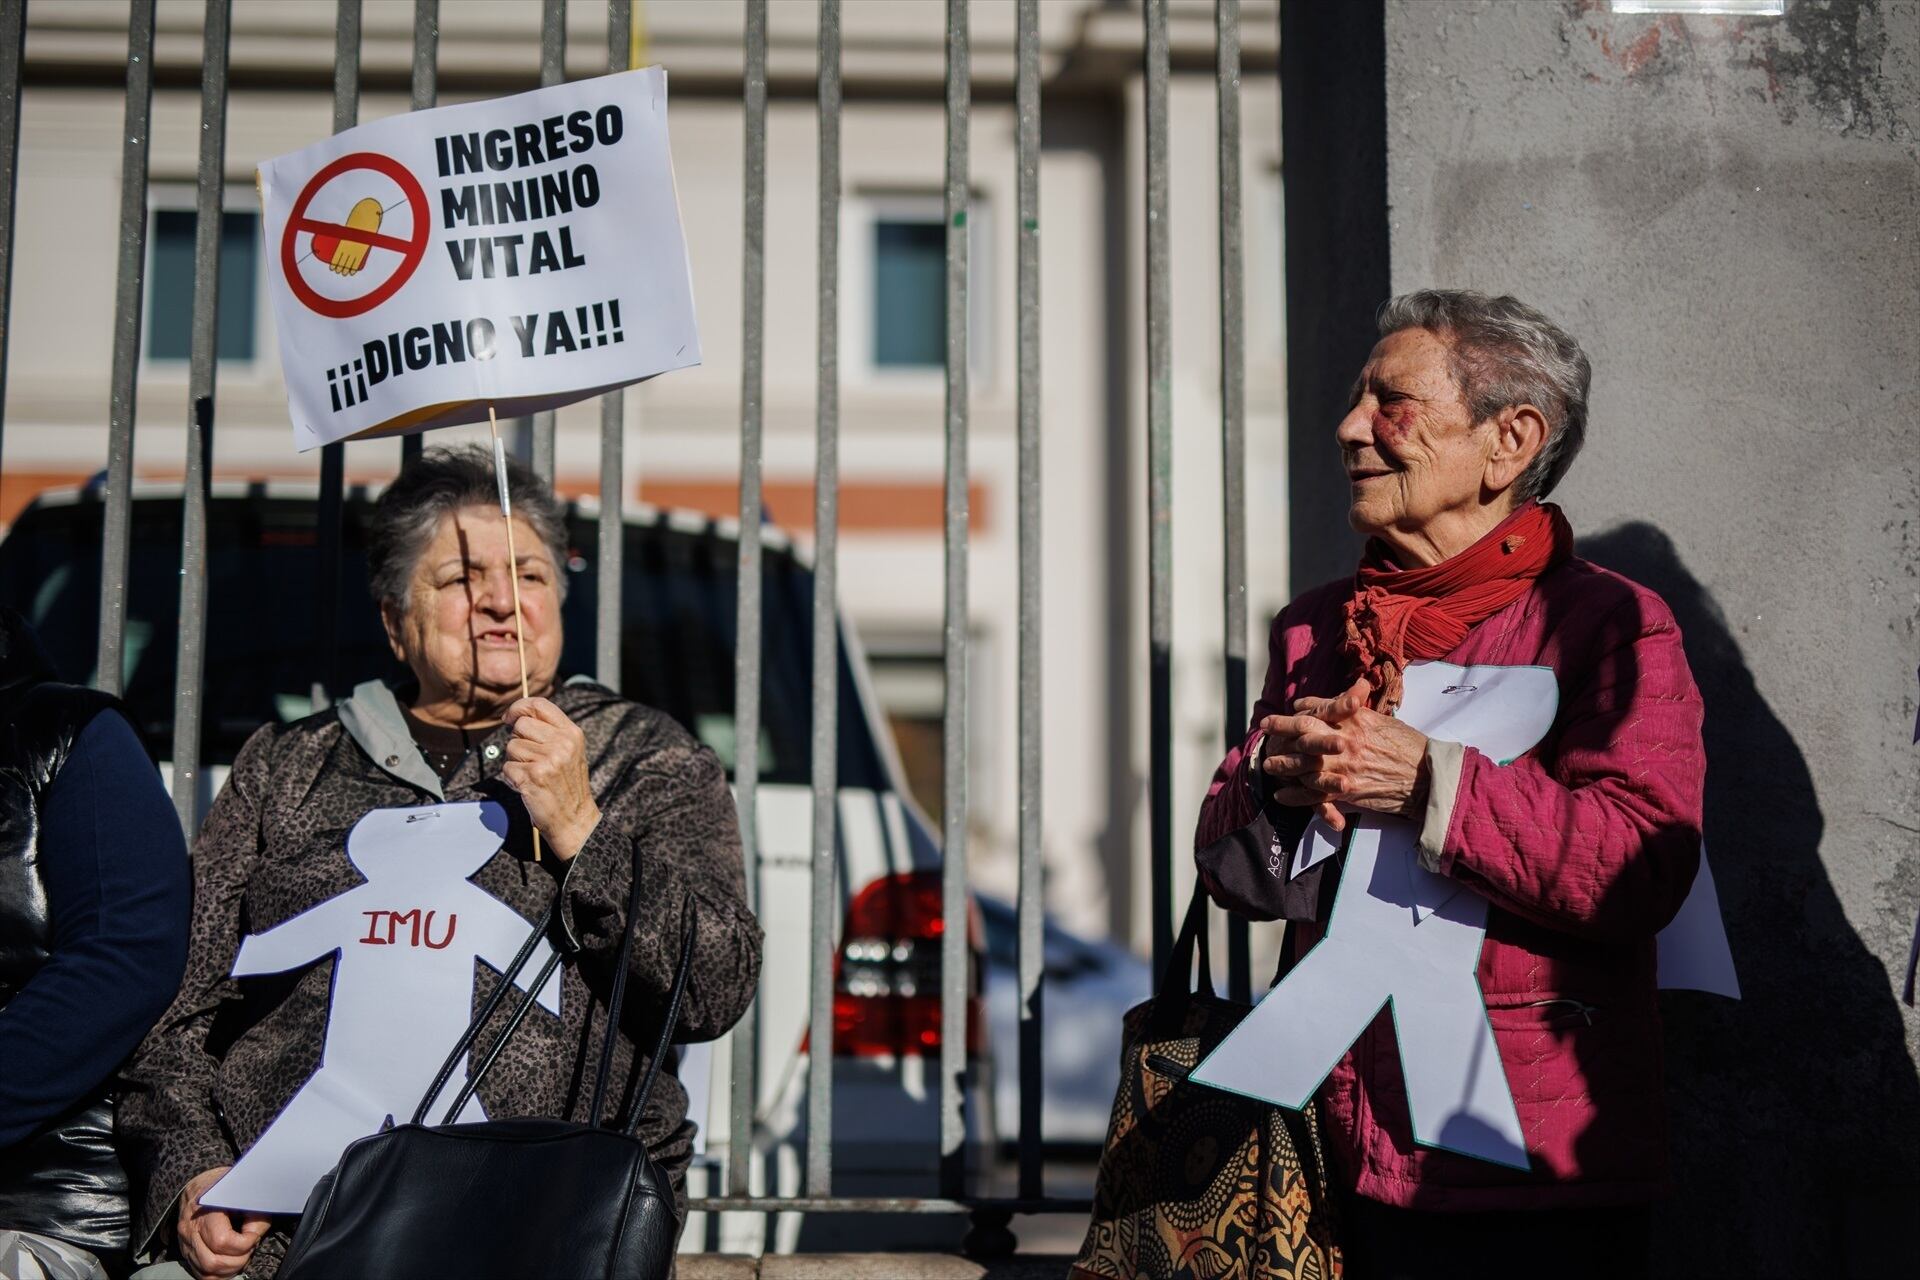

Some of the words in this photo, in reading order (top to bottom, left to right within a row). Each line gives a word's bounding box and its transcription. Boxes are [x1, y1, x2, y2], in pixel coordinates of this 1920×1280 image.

[434, 104, 624, 178] INGRESO
[440, 163, 601, 229] MININO
[445, 225, 586, 281] VITAL
[326, 317, 498, 413] ¡¡¡DIGNO
[509, 298, 625, 358] YA!!!
[359, 908, 457, 949] IMU
